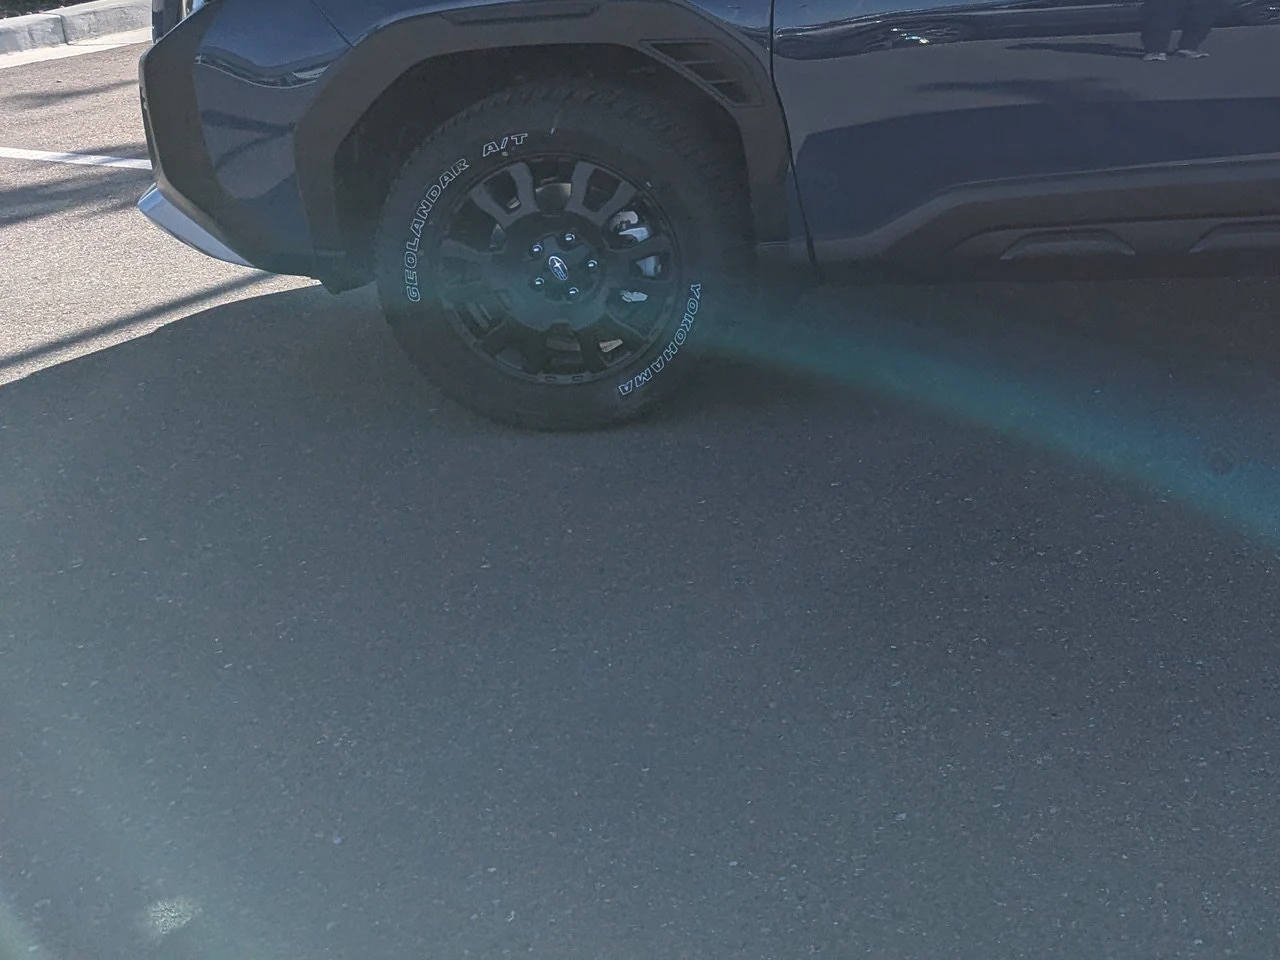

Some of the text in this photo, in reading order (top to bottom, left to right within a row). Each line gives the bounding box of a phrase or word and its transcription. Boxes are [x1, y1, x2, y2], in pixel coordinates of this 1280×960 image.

[405, 133, 528, 303] GEOLANDAR A/T
[619, 283, 701, 396] YOKOHAMA
